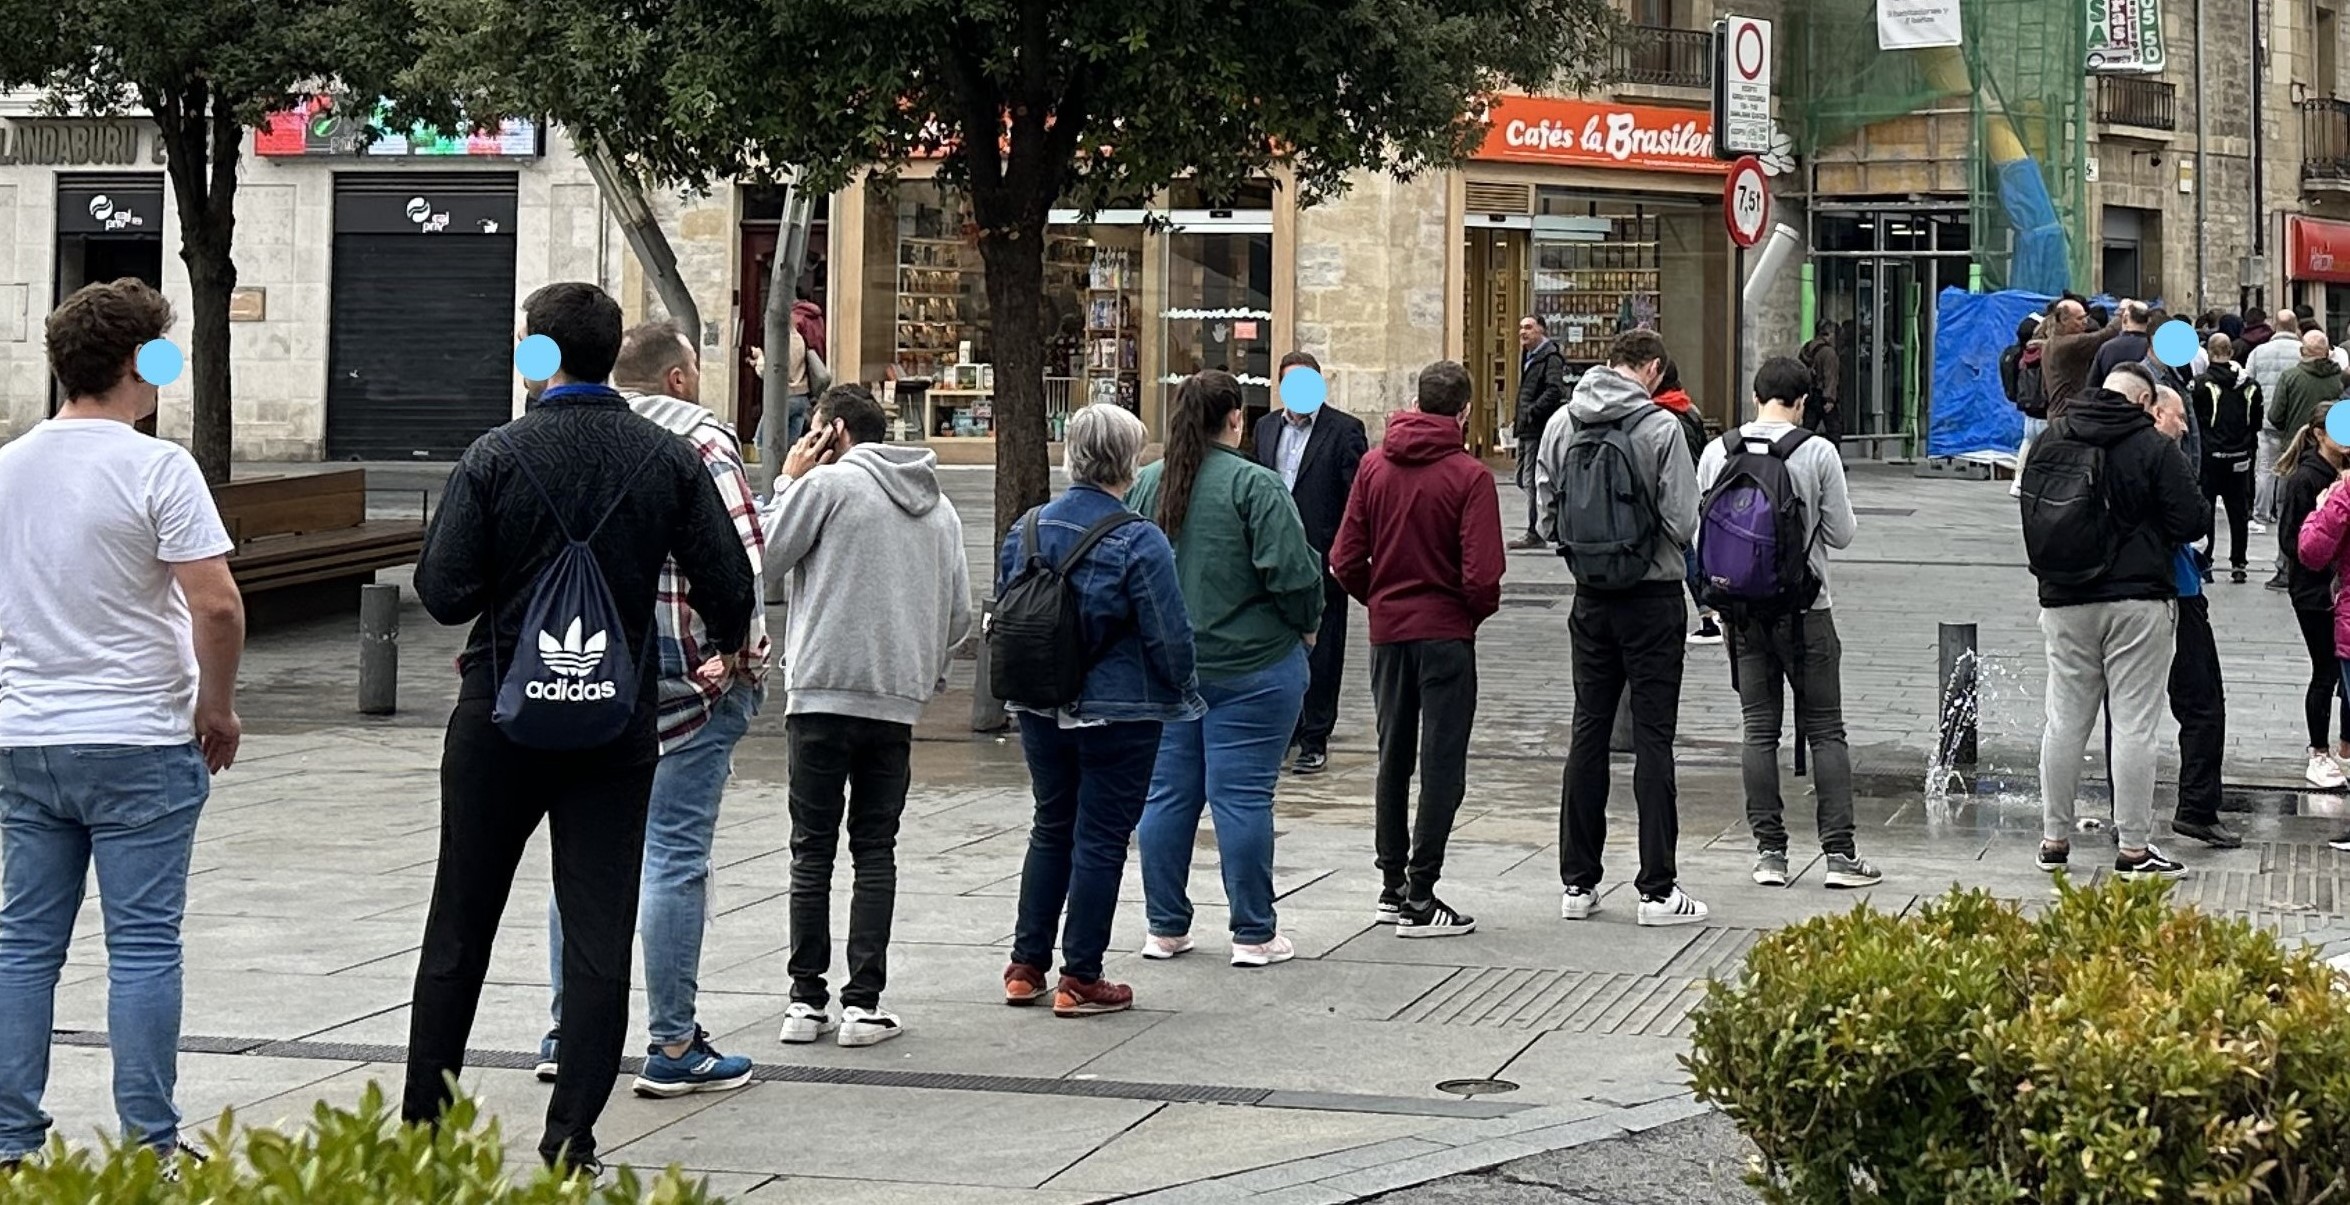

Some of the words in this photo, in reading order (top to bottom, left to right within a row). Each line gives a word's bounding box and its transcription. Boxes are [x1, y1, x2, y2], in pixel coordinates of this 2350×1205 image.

[1506, 118, 1574, 150] Cafés
[1579, 114, 1604, 153] la
[1606, 112, 1712, 160] Brasile
[1738, 185, 1761, 216] 7,5t
[525, 678, 616, 701] adidas
